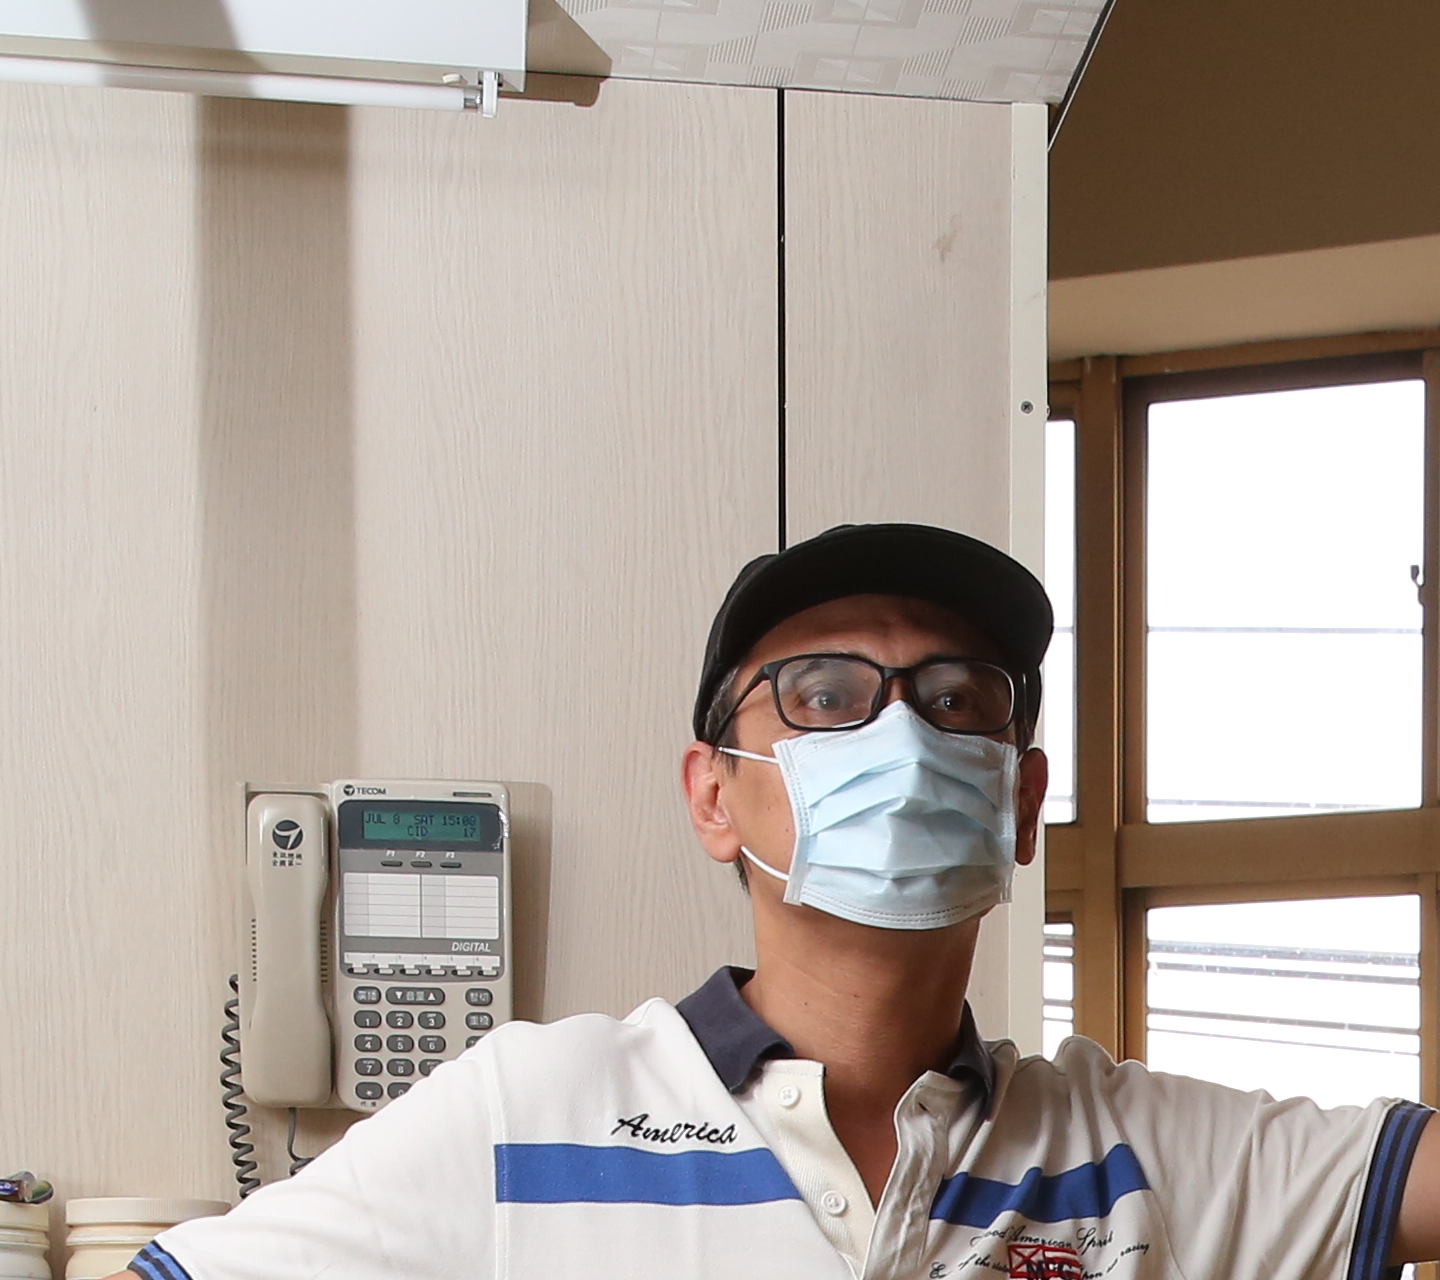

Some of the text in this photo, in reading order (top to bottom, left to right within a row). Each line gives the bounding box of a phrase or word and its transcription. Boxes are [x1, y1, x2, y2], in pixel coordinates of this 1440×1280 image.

[356, 787, 387, 795] TECOM
[365, 814, 385, 825] JUL
[414, 815, 435, 826] SAT
[408, 826, 476, 838] CID 17
[452, 942, 492, 952] DIGITAL
[611, 1112, 740, 1146] America
[1011, 1226, 1072, 1249] American
